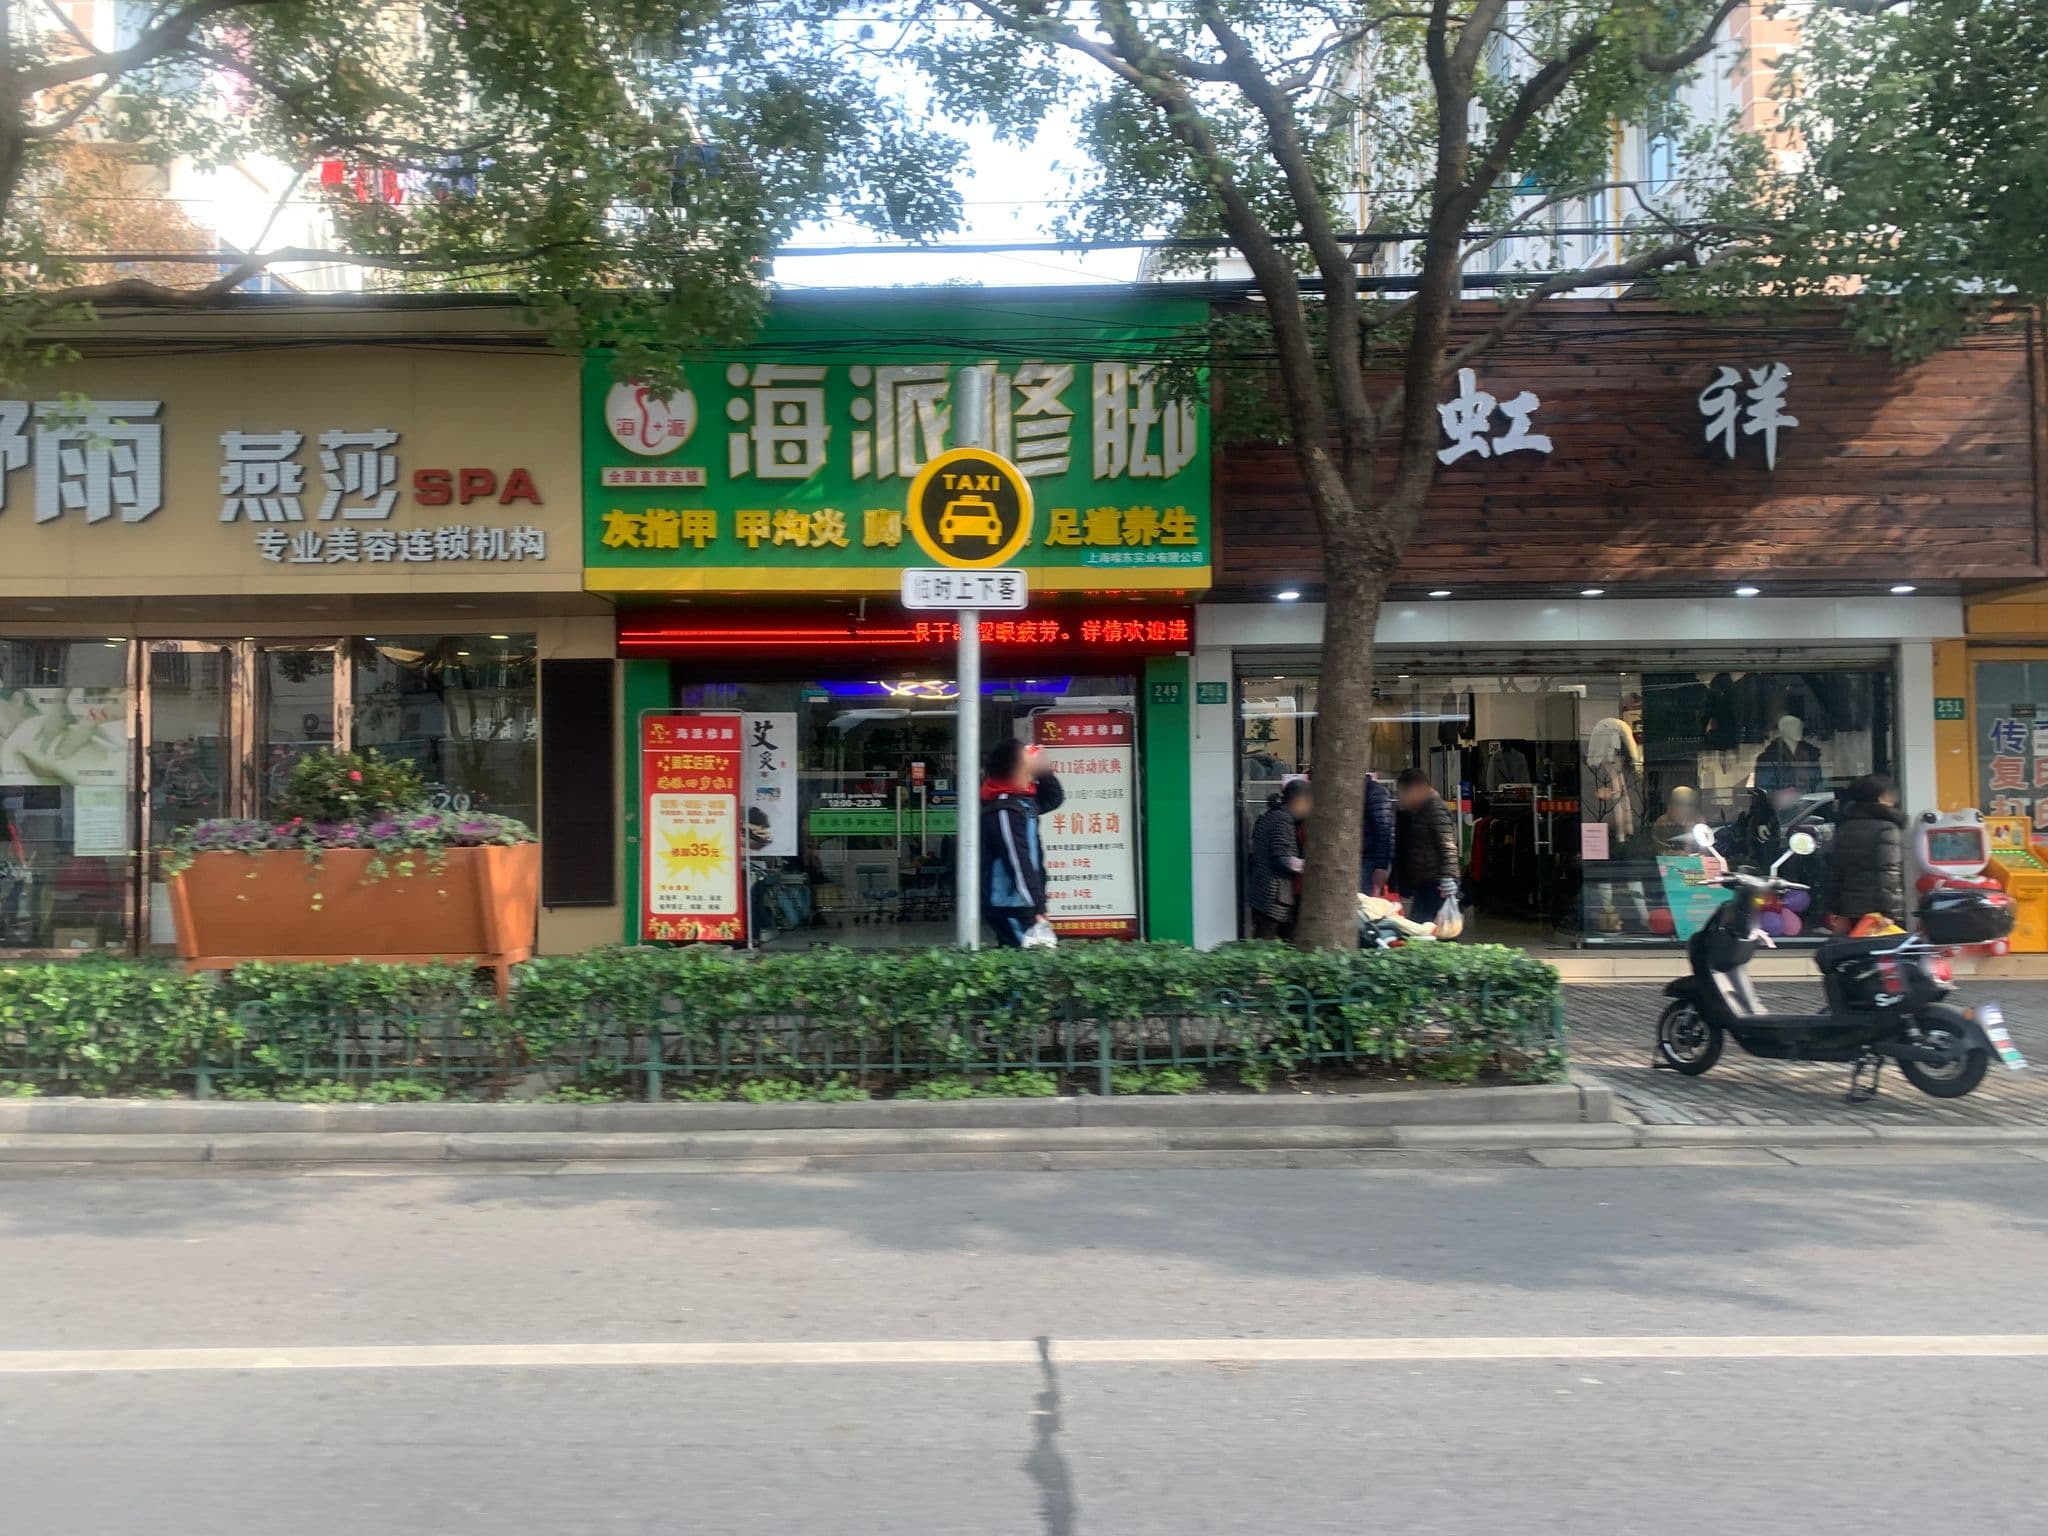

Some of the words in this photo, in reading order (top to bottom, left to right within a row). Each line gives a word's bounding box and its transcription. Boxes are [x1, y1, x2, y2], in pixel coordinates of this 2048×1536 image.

[0, 400, 161, 524] 雨
[219, 428, 400, 523] 燕莎
[414, 467, 543, 506] SPA
[942, 474, 1001, 491] TAXI
[602, 508, 717, 548] 灰指甲
[1045, 506, 1199, 546] 足道养生
[256, 527, 547, 564] 专业美容连锁机构
[914, 576, 1015, 601] 临时上下客
[1154, 684, 1179, 697] 249
[1937, 700, 1962, 713] 251
[1988, 718, 2048, 754] 传
[1053, 812, 1120, 835] 半价活动
